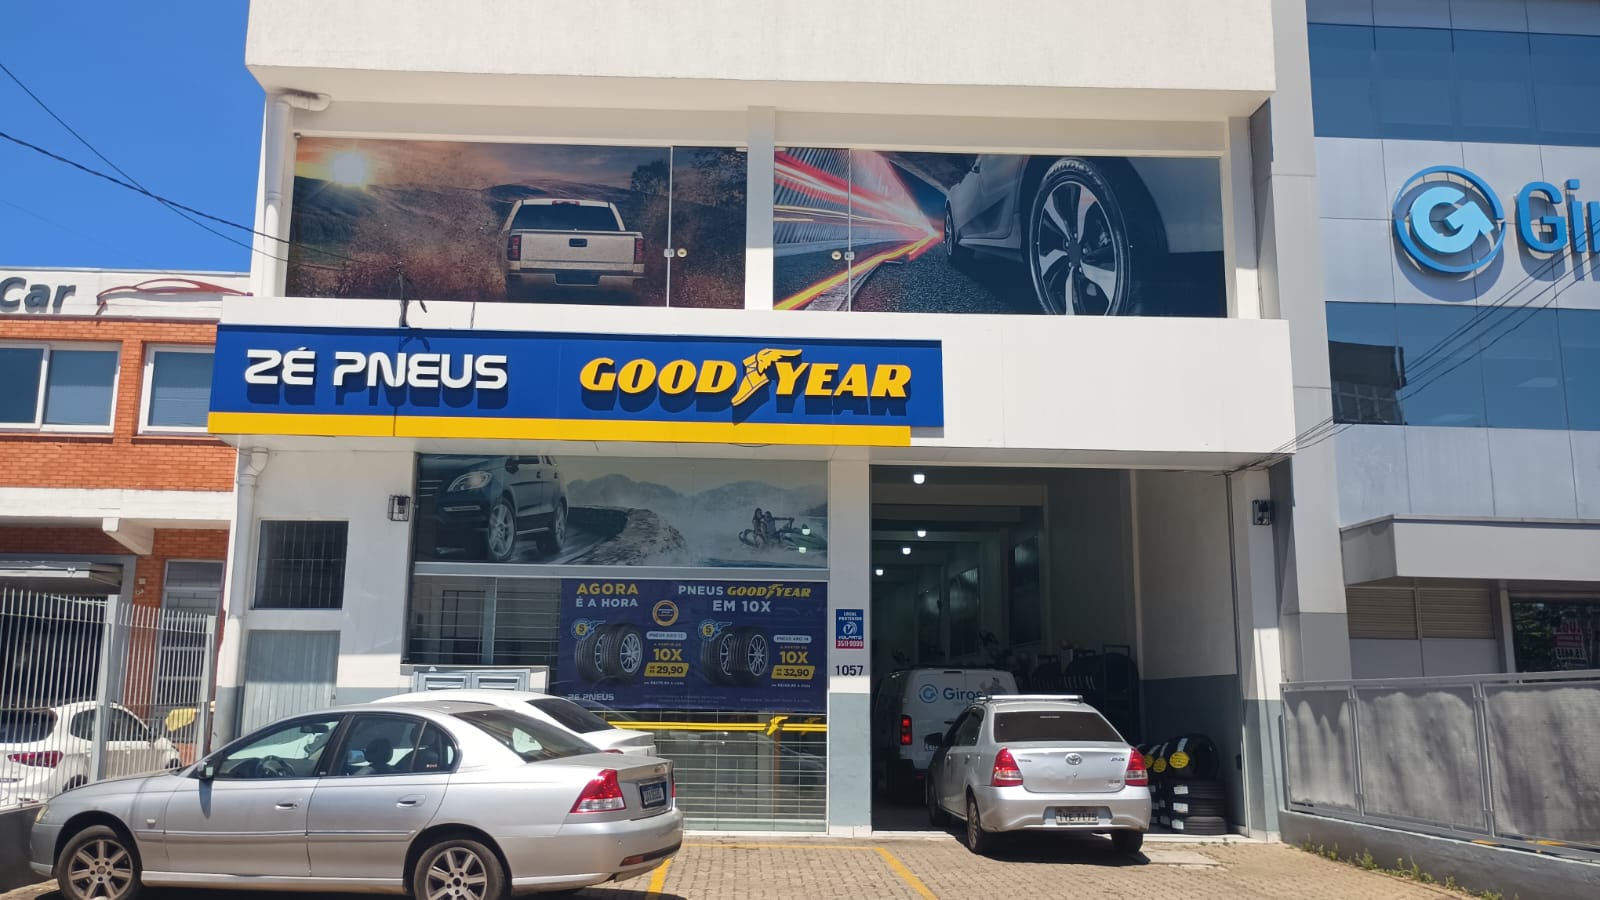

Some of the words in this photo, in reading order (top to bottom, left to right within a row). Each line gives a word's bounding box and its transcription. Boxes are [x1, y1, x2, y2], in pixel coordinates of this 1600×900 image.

[0, 277, 76, 307] Car
[244, 347, 316, 386] ZÉ
[333, 351, 508, 389] PNEUS
[576, 583, 639, 595] AGORA
[678, 585, 724, 595] PNEUS
[575, 596, 584, 607] É
[587, 599, 597, 607] A
[601, 599, 639, 607] HORA
[712, 600, 736, 612] EM
[742, 601, 771, 612] 10X
[653, 648, 682, 661] 10X
[779, 651, 808, 664] 10X
[656, 665, 683, 675] 29,90
[783, 668, 809, 678] 32,90
[835, 665, 863, 676] 1057
